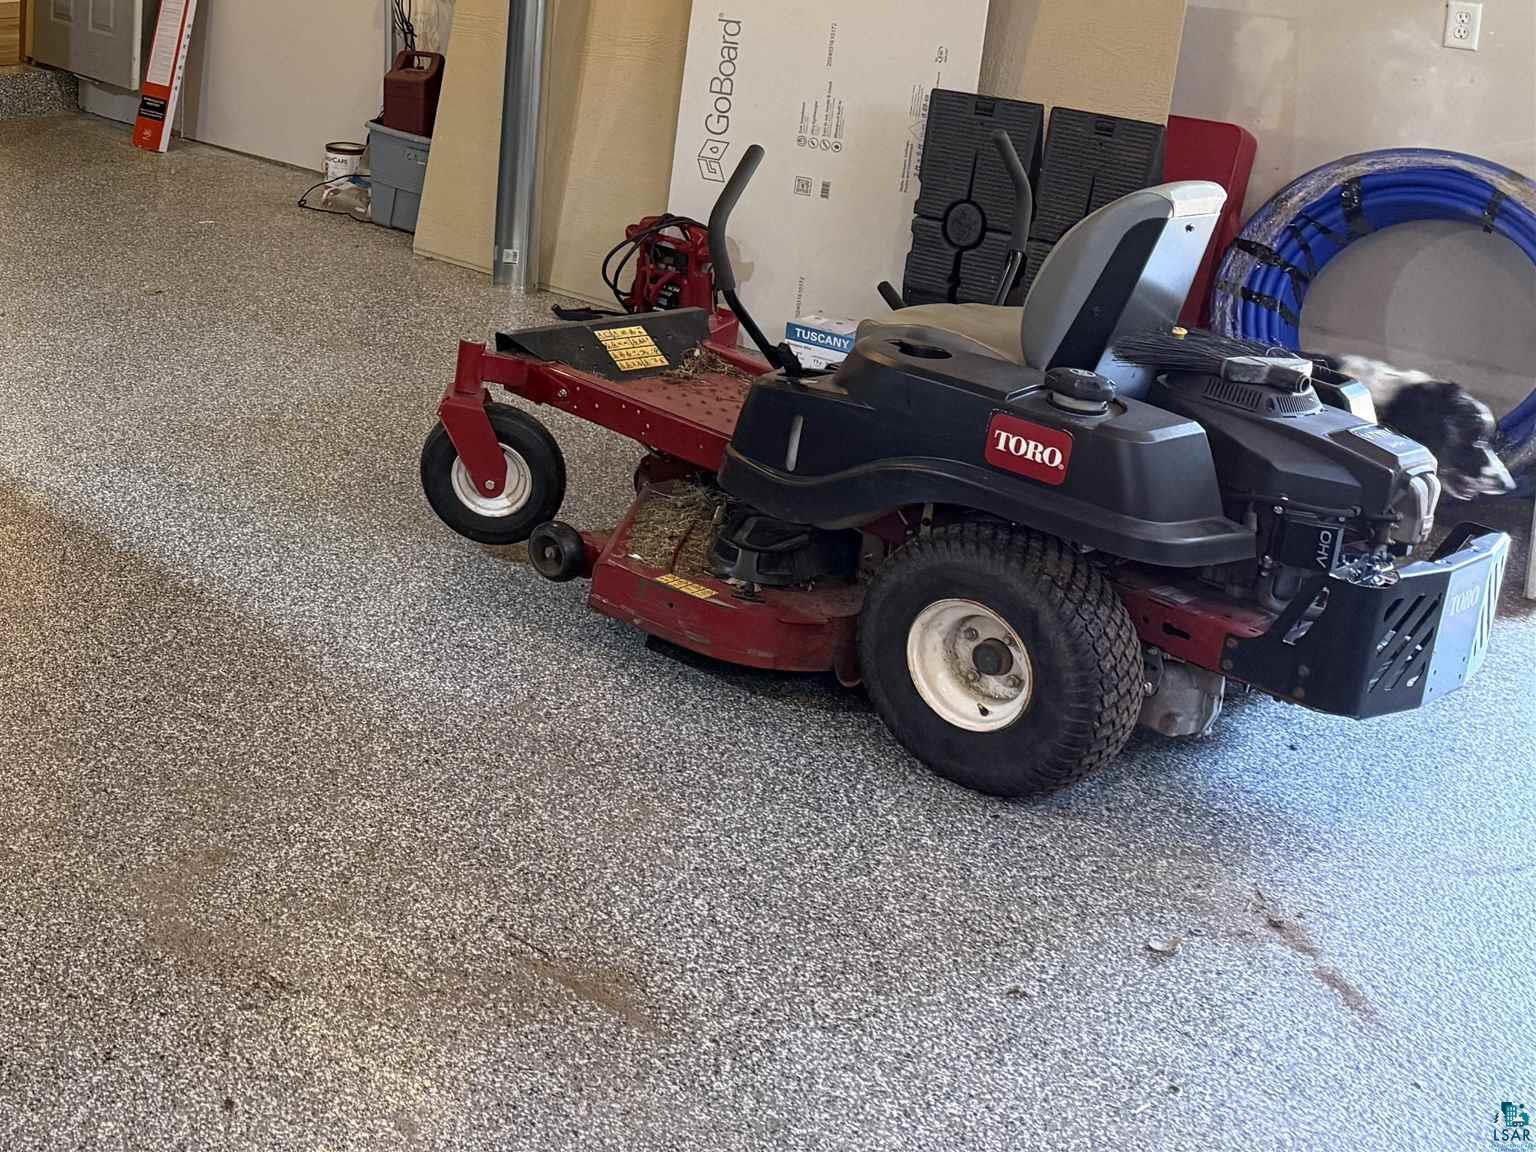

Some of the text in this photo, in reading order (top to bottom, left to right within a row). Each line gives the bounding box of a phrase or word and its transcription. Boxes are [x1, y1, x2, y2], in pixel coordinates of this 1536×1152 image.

[795, 327, 850, 349] TUSCANY
[993, 429, 1063, 467] TORO
[1316, 529, 1333, 569] OHV
